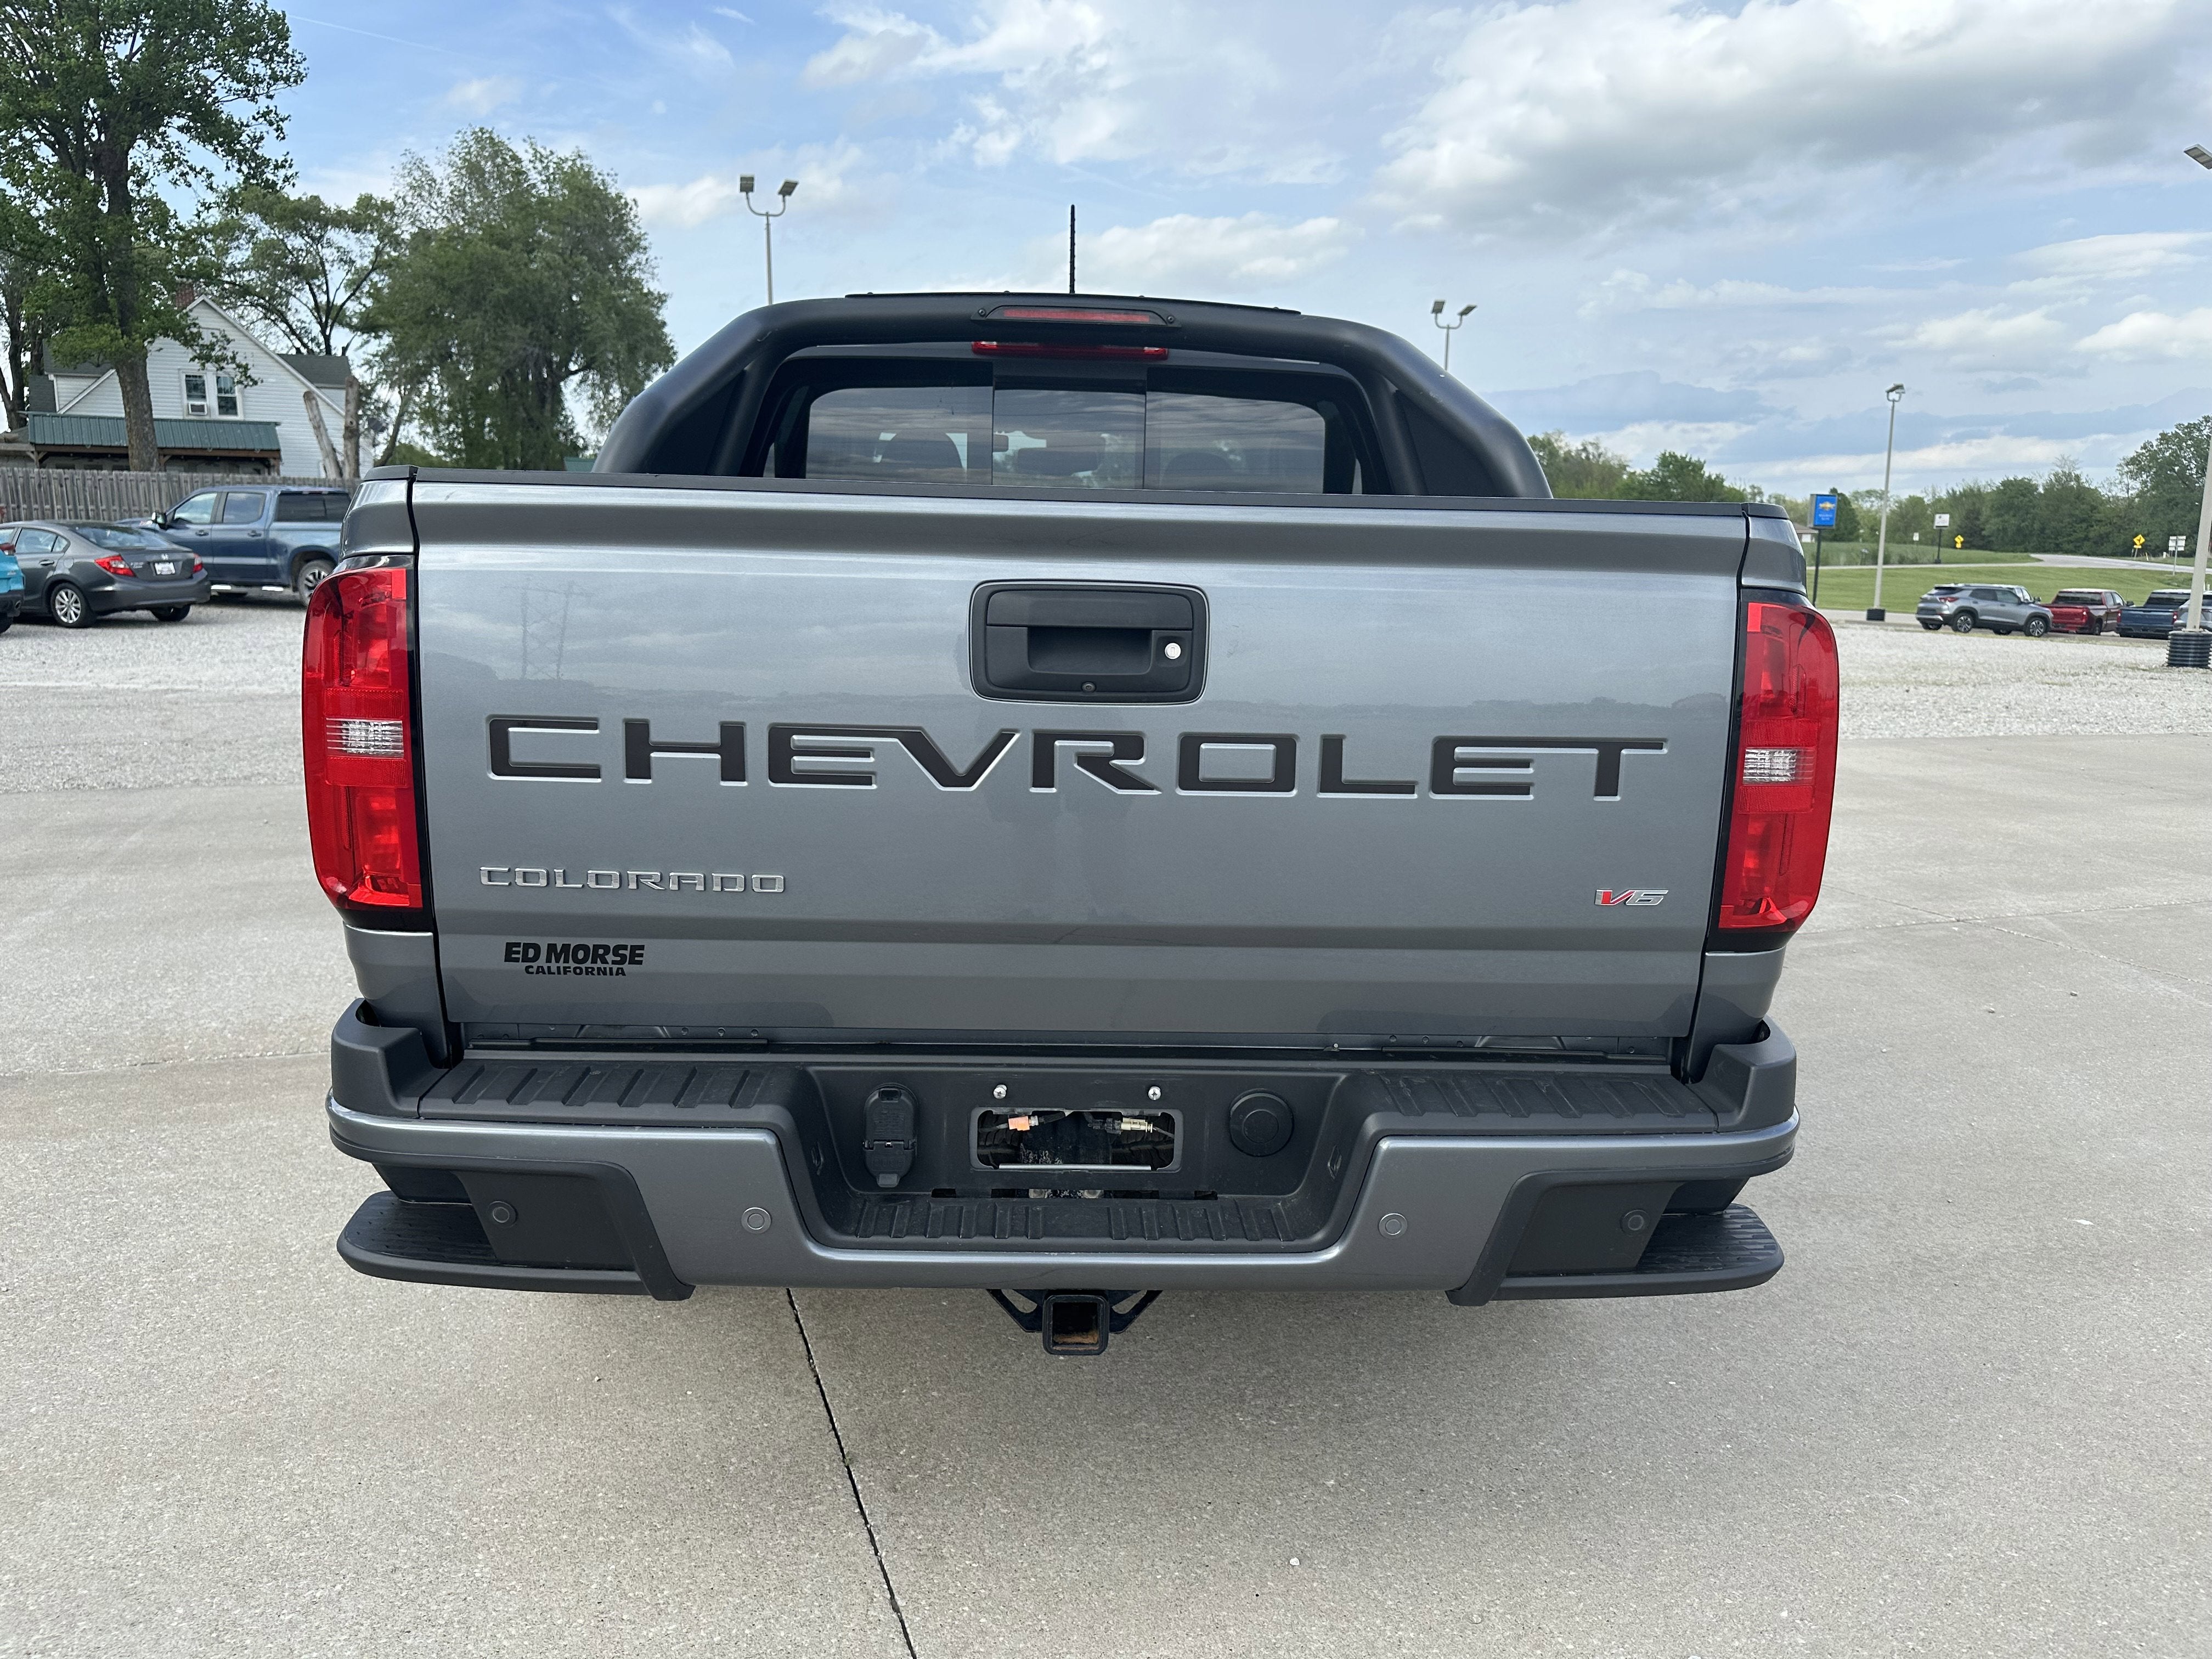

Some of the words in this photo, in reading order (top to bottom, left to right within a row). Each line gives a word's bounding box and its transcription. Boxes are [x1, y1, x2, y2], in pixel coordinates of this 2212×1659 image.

[486, 714, 1668, 801] CHEVROLET
[479, 866, 785, 893] COLORADO
[1594, 889, 1669, 906] V6
[504, 942, 541, 963] ED
[545, 944, 645, 965] MORSE
[524, 965, 626, 976] CALIFORNIA
